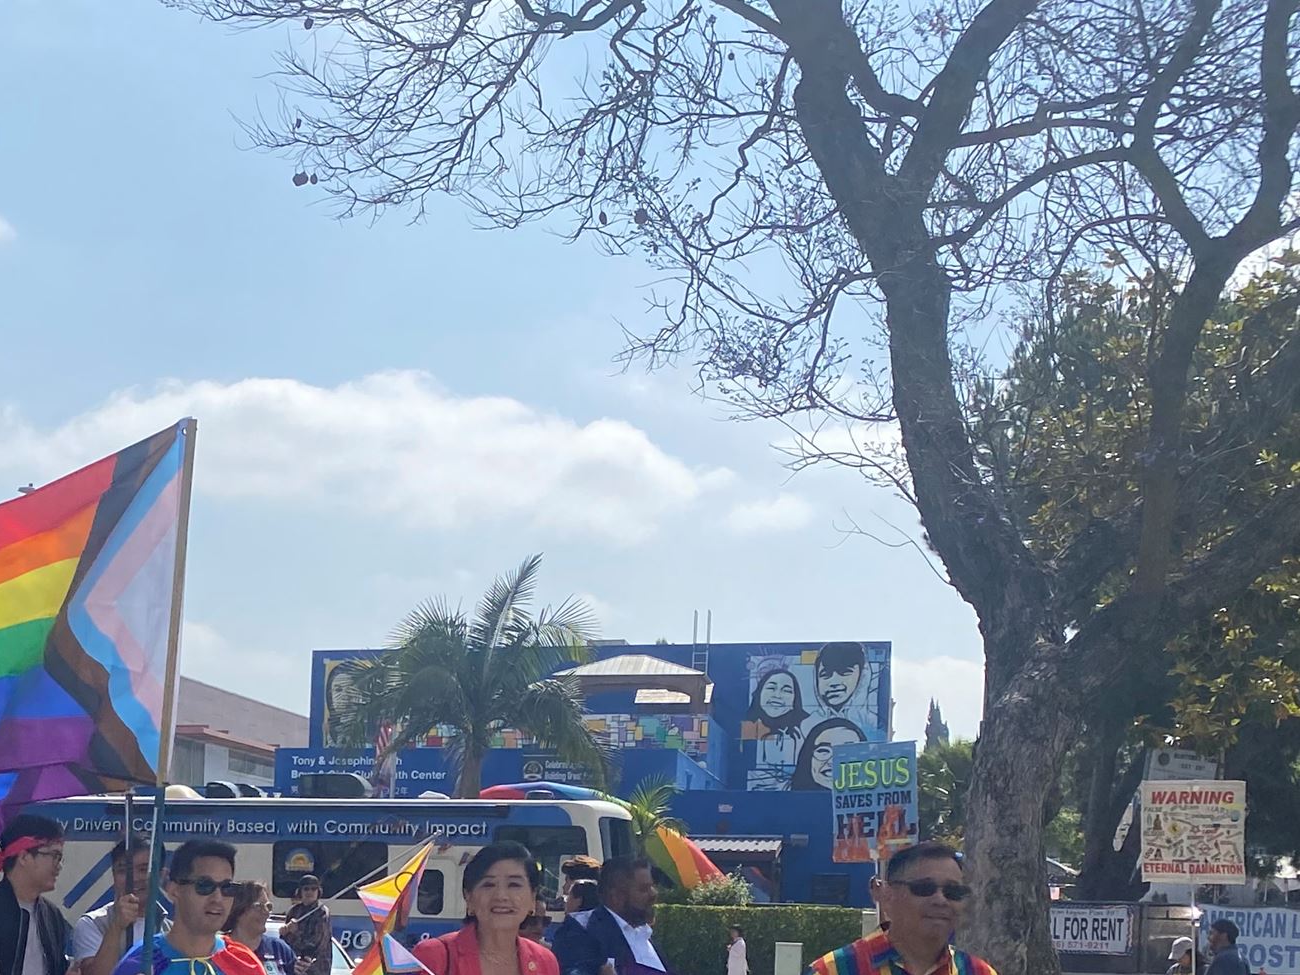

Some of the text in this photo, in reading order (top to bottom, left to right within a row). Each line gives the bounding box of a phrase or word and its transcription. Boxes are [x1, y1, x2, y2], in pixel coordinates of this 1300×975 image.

[292, 756, 315, 767] Tony
[318, 756, 326, 766] &
[411, 770, 447, 780] Center
[834, 756, 910, 791] JESUS
[835, 790, 912, 809] SAVES FROM
[1151, 791, 1235, 804] WARNING
[74, 817, 121, 831] Driven
[227, 818, 279, 834] Based,
[287, 819, 317, 833] with
[426, 821, 487, 838] Impact
[836, 808, 917, 839] HELL
[1143, 862, 1243, 874] ETERNAL DAMNATION
[1063, 917, 1088, 940] FOR
[1091, 917, 1124, 941] RENT
